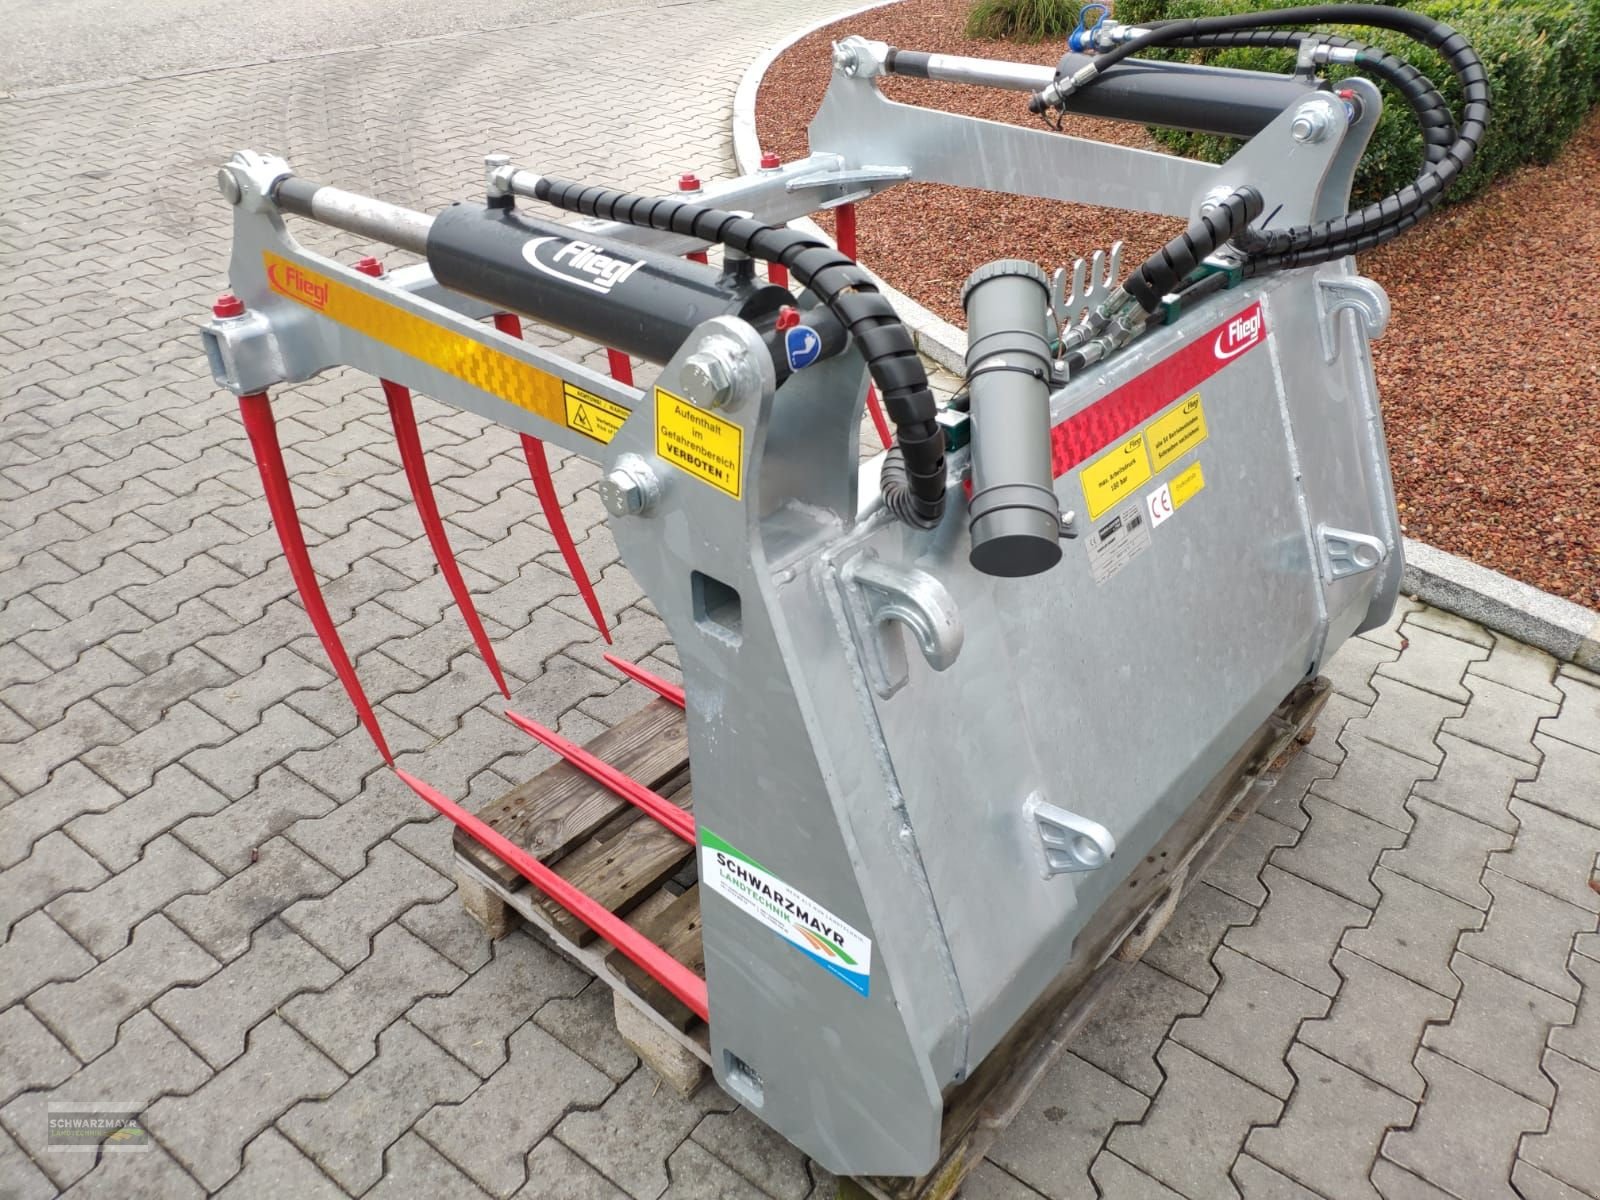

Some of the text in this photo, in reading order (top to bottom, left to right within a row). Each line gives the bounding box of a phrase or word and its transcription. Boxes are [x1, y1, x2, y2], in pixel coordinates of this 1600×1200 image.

[552, 240, 648, 288] Fliegl
[286, 265, 328, 306] Fliegl
[1228, 306, 1261, 346] Fliegl
[675, 405, 721, 435] Aufenthalt
[692, 427, 704, 440] im
[661, 425, 735, 471] Gefahrenbereich
[666, 442, 722, 479] VERBOTEN
[1119, 475, 1128, 485] bar
[717, 852, 844, 947] SCHWARZMAYR
[720, 868, 790, 923] LANDTECHNIK
